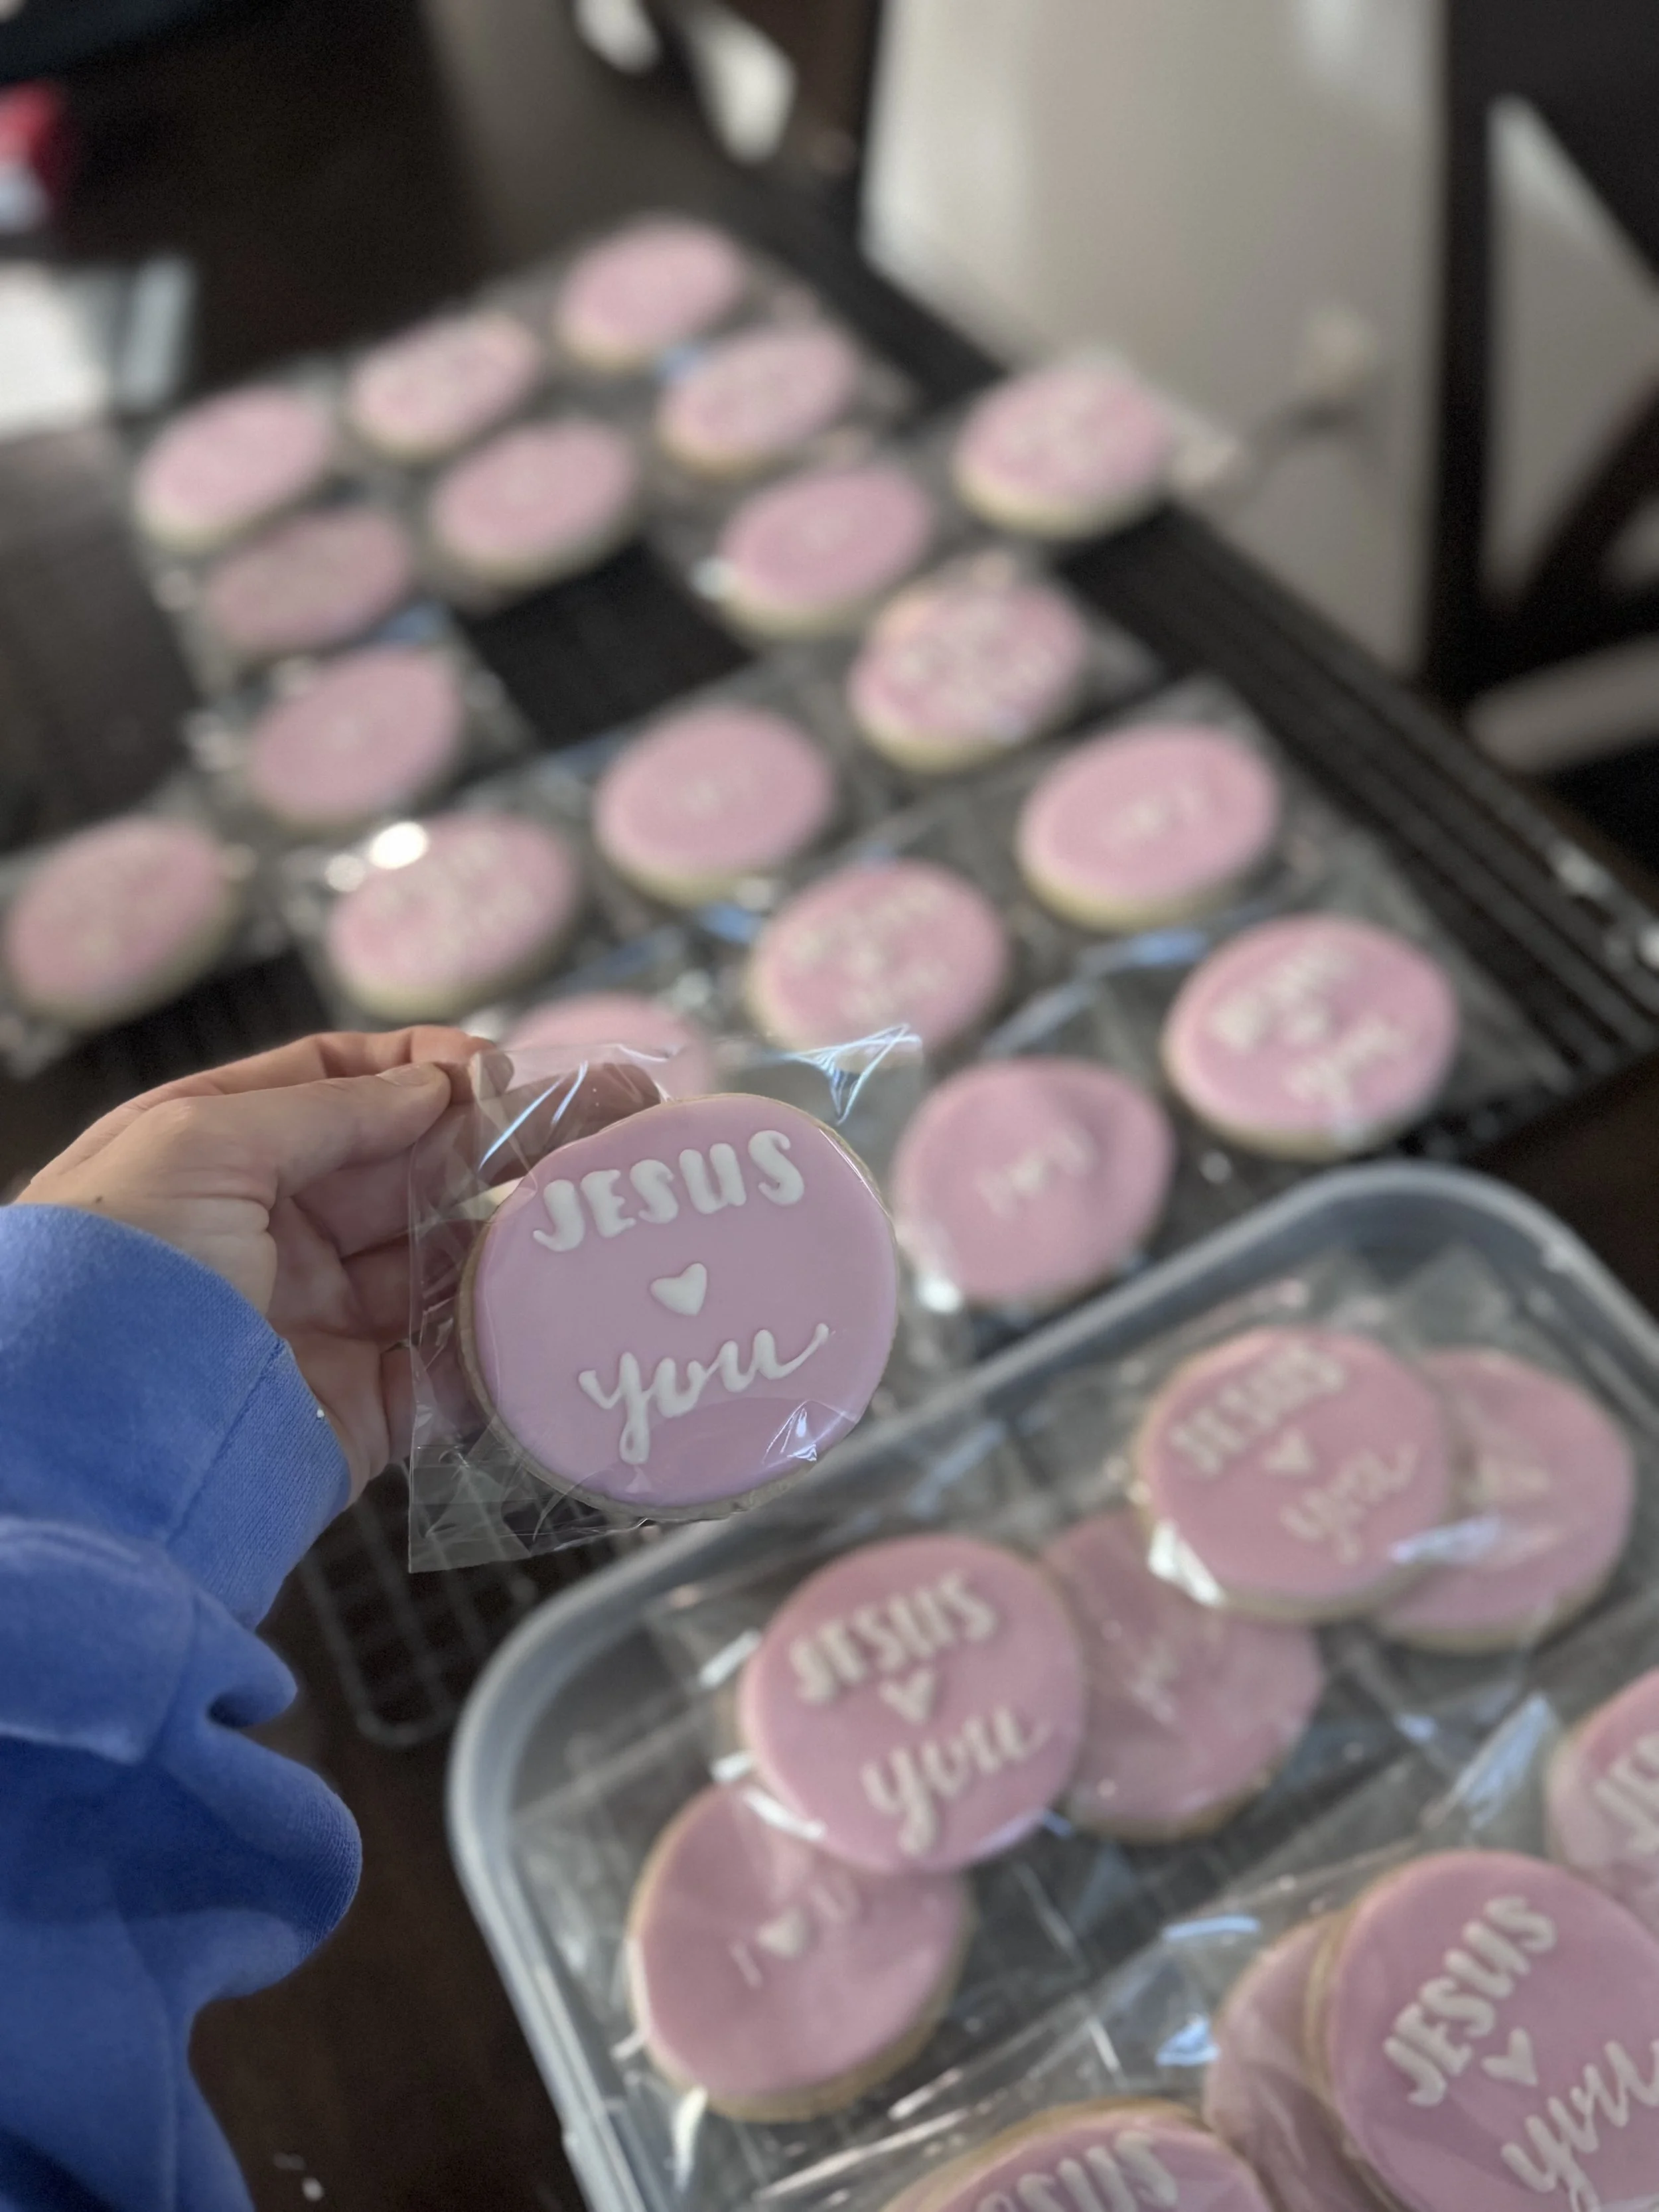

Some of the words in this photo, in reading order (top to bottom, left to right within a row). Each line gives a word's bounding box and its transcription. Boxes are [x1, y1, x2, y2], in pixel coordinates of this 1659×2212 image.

[533, 1130, 805, 1252] JESUS
[578, 1323, 833, 1464] you
[790, 1572, 997, 1703] JESUS
[861, 1706, 1052, 1856] you
[1384, 1896, 1558, 2106] JESUS
[1500, 2039, 1659, 2212] you
